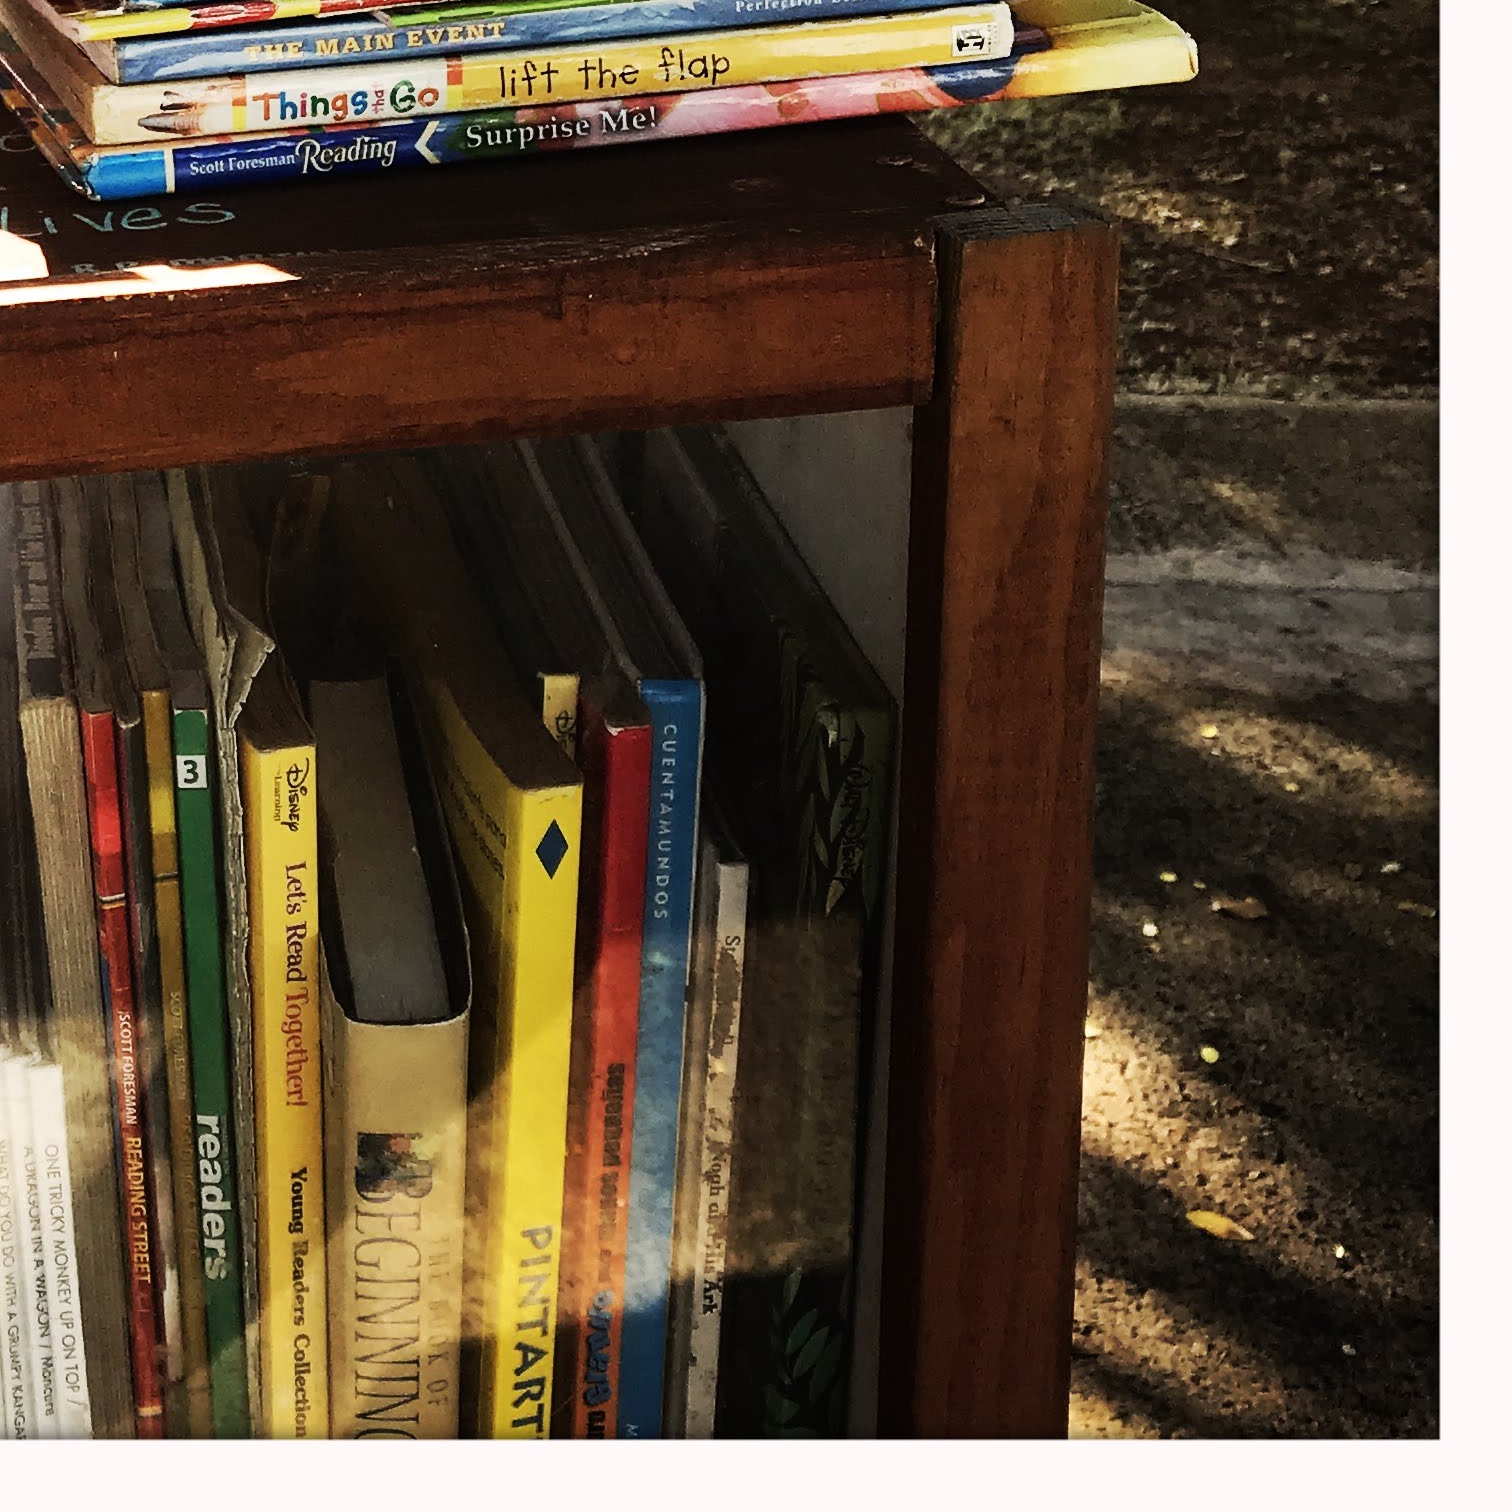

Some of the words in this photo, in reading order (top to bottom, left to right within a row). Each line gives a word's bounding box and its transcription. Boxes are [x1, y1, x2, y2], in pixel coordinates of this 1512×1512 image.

[244, 37, 304, 62] THE
[314, 30, 395, 58] MAIN
[407, 20, 507, 52] EVENT
[252, 90, 369, 129] Things
[388, 79, 441, 115] Go
[497, 56, 560, 98] lift
[577, 54, 641, 93] the
[656, 47, 732, 94] flap
[189, 155, 225, 178] Scott
[227, 151, 298, 174] Foresman
[294, 131, 399, 176] Reading
[464, 111, 591, 151] Surprise
[598, 107, 660, 136] Me!
[654, 722, 678, 920] CUENTAMUNDOS
[285, 859, 308, 916] Let's
[286, 920, 309, 985] Read
[118, 1011, 136, 1055] SCOTT
[182, 759, 199, 785] 3
[195, 1114, 233, 1281] readers
[280, 988, 311, 1108] Together!
[121, 1056, 139, 1125] FORESMAN
[44, 1143, 62, 1179] ONE
[125, 1136, 148, 1217] READING
[0, 1211, 14, 1242] YOU
[46, 1185, 66, 1234] TRICKY
[288, 1166, 310, 1235] Young
[2, 1244, 15, 1268] DO
[31, 1235, 43, 1254] IN
[52, 1240, 74, 1306] MONKEY
[130, 1220, 152, 1284] STREET
[4, 1271, 18, 1312] WITH
[34, 1274, 52, 1339] WAGON
[290, 1240, 311, 1319] Readers
[702, 1278, 724, 1316] Ark
[59, 1311, 75, 1333] UP
[60, 1337, 77, 1361] ON
[7, 1326, 23, 1381] GRUMPY
[64, 1362, 82, 1395] TOP
[292, 1324, 312, 1438] Collection
[39, 1355, 56, 1417] Moncure
[426, 1377, 451, 1406] OF
